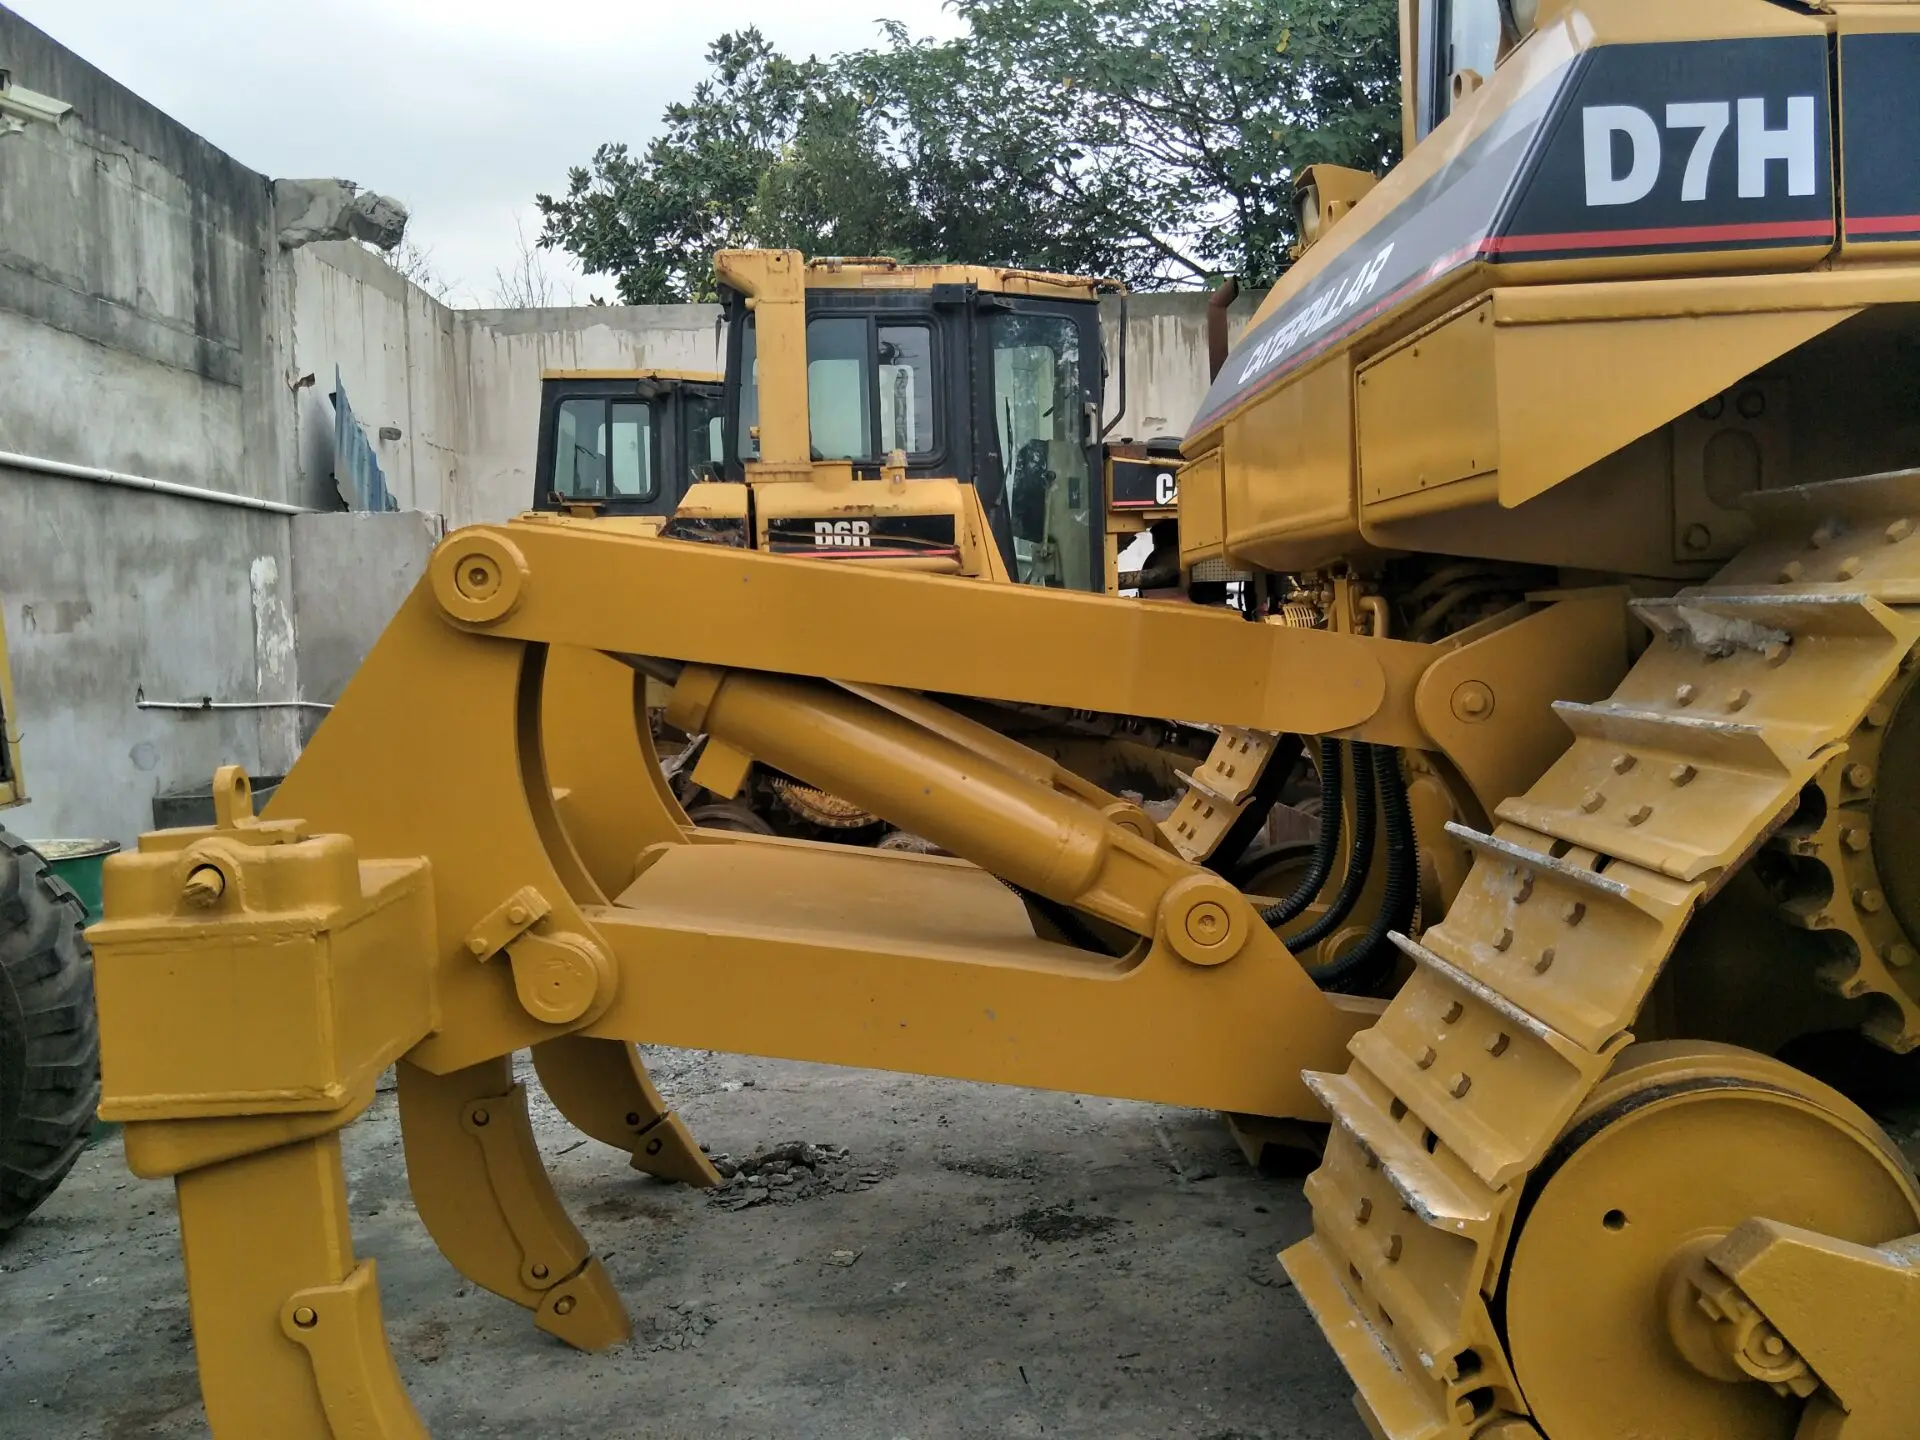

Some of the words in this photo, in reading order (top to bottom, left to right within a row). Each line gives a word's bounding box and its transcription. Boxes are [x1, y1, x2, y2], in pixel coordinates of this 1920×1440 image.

[1583, 97, 1815, 206] D7H
[1238, 242, 1395, 384] CATERPILLAR
[814, 521, 871, 547] D6R
